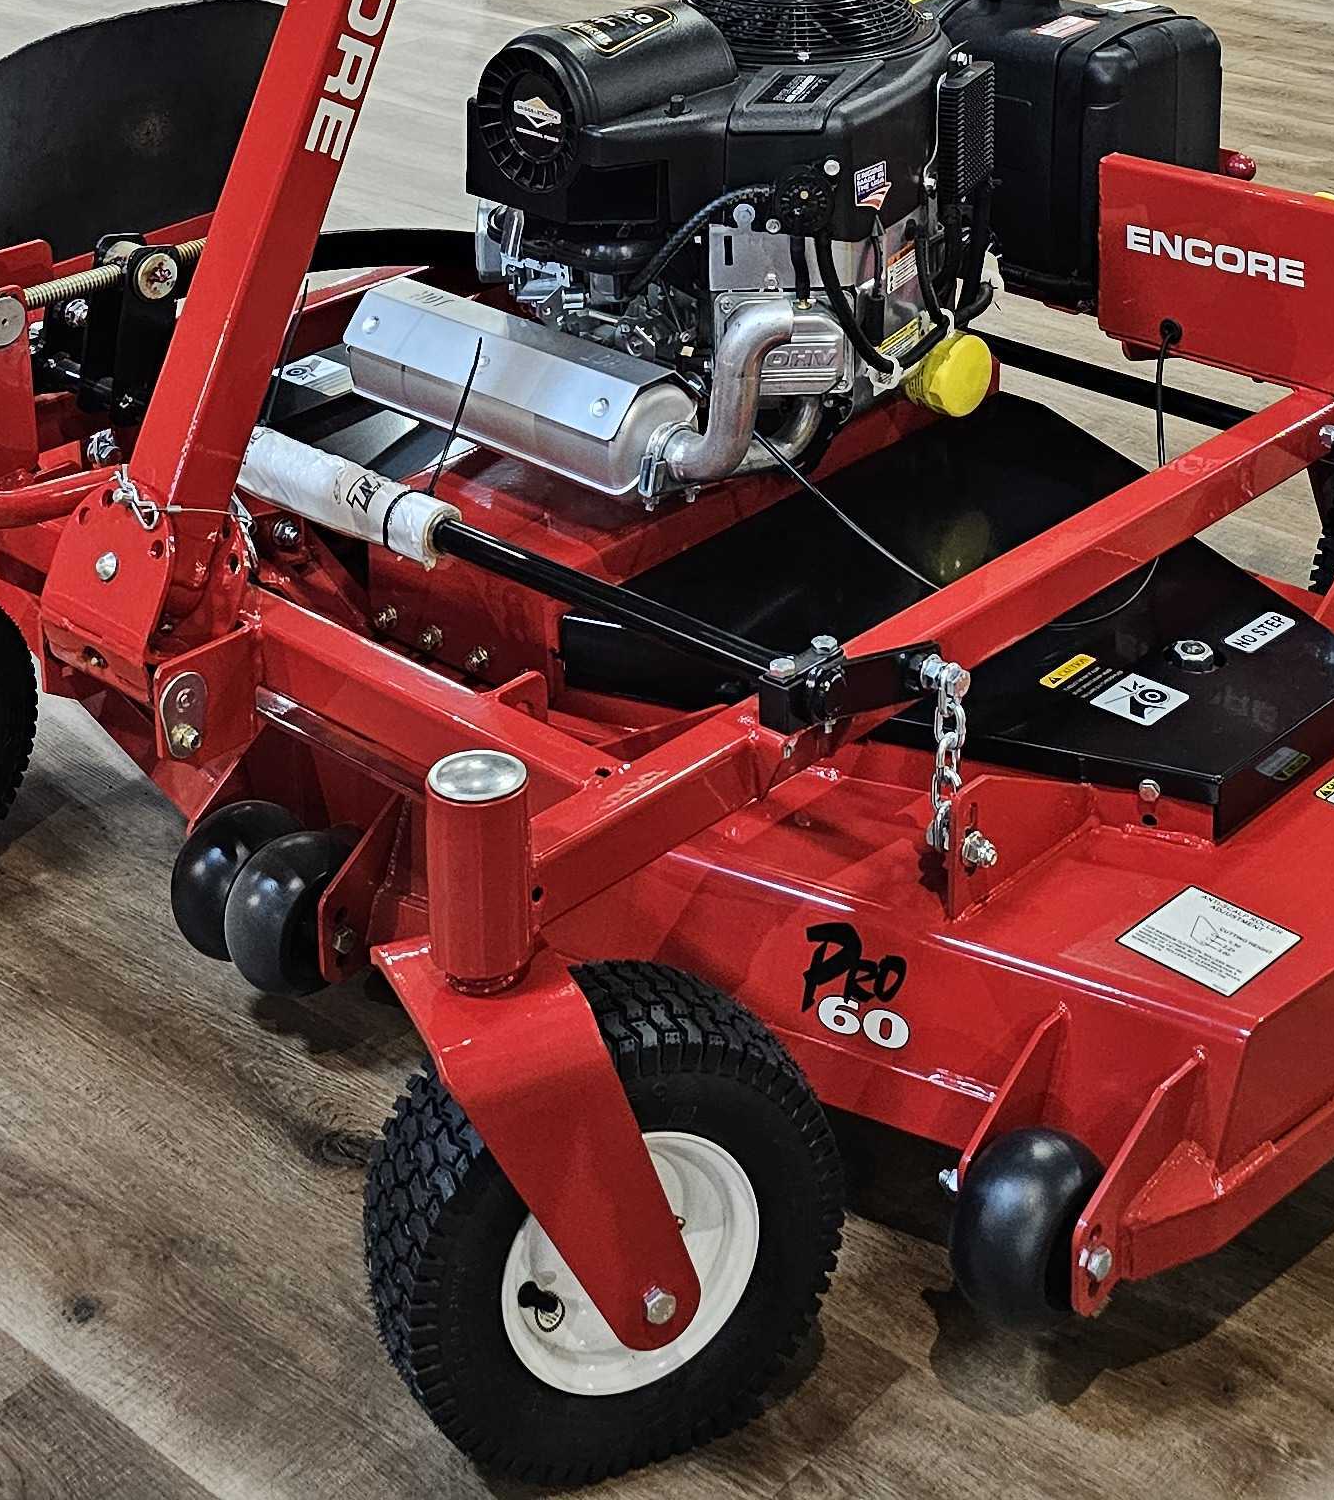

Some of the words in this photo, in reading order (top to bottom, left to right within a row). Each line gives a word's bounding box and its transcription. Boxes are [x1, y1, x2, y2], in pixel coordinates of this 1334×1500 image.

[857, 174, 875, 187] MADE
[857, 181, 870, 192] THE
[871, 176, 885, 189] USA
[1126, 224, 1305, 288] ENCORE
[764, 348, 837, 367] OHV
[1232, 634, 1257, 648] NO
[1253, 614, 1286, 637] STEP
[1210, 905, 1266, 933] ADJUSTMENT
[1249, 916, 1284, 935] ROLLER
[818, 994, 911, 1050] 60
